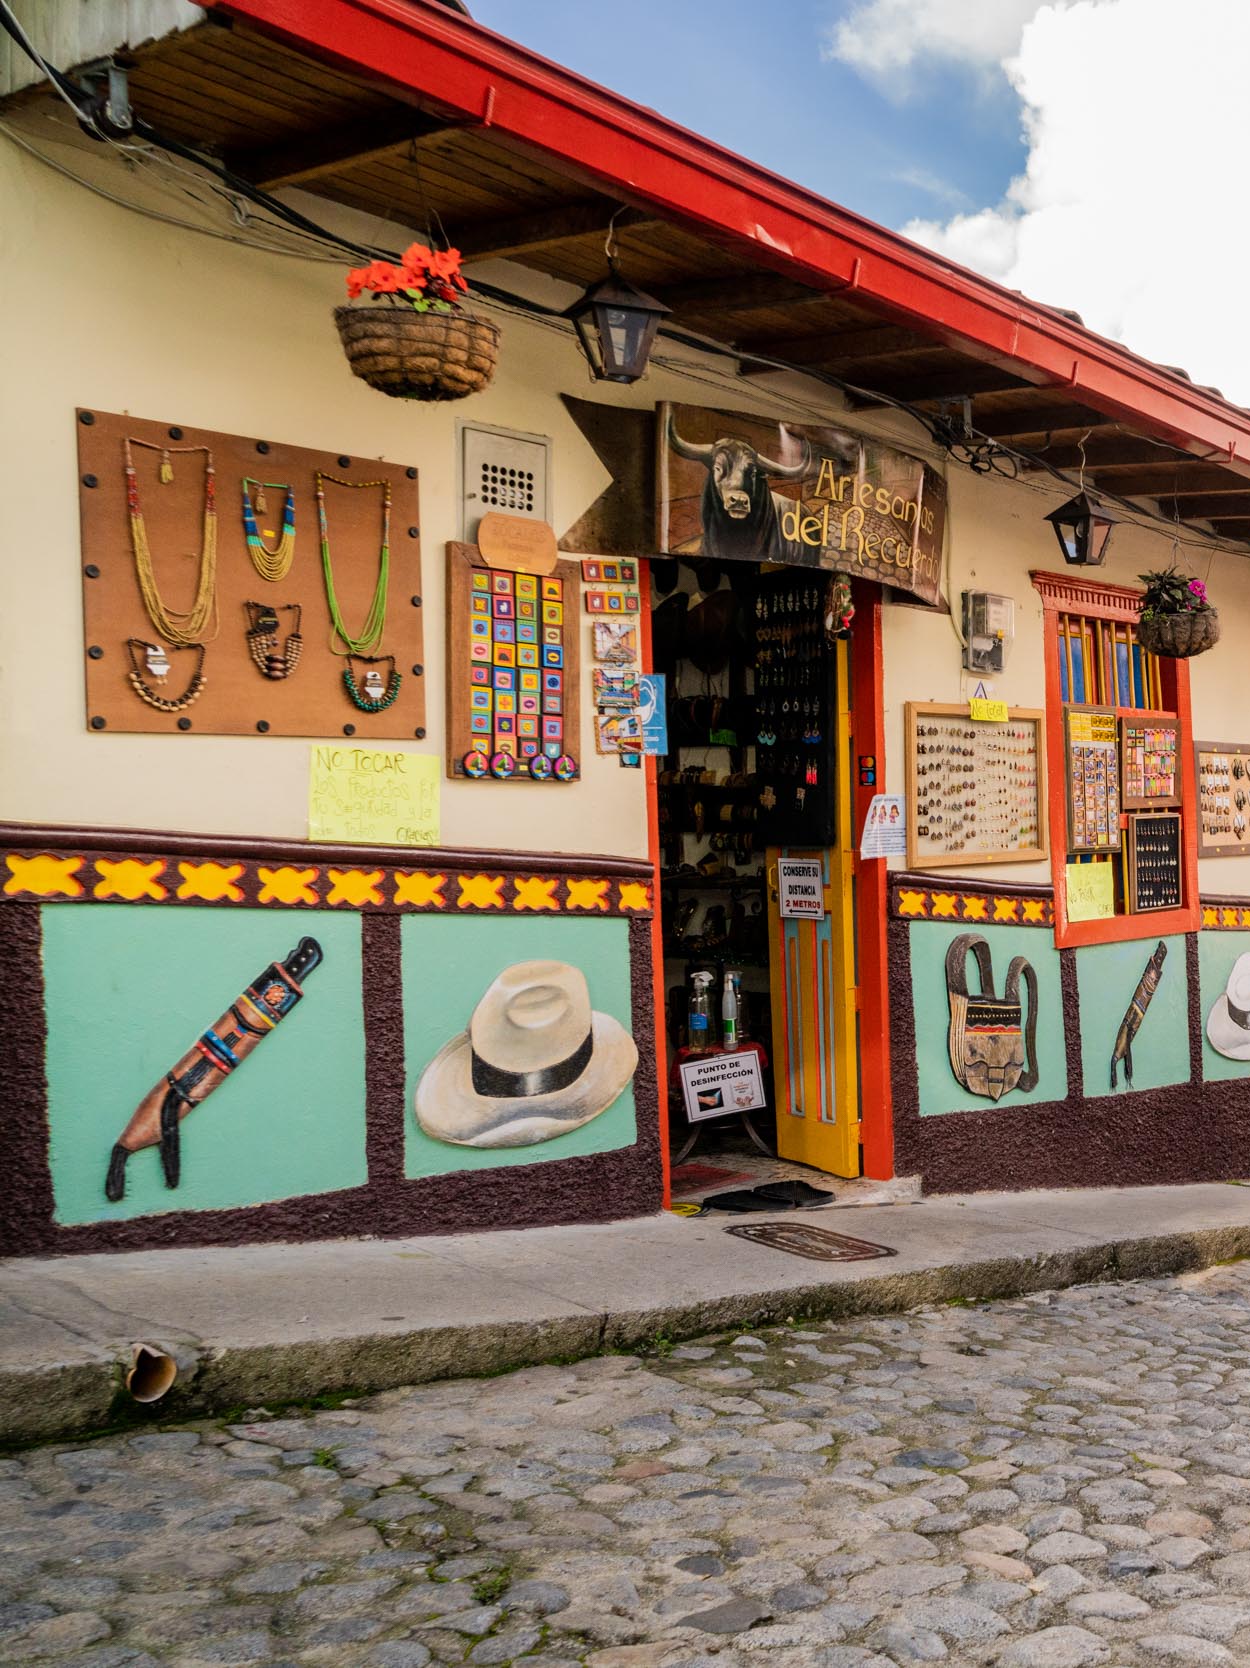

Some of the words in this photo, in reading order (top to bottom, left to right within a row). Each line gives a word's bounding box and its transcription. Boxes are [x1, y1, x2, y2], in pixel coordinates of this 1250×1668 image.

[814, 457, 934, 536] Artesanas
[781, 500, 829, 547] del
[838, 505, 939, 583] Recuerdo
[316, 747, 342, 772] NO
[350, 749, 408, 775] TOCAR
[783, 866, 812, 877] CONSERVE
[812, 866, 819, 877] SU
[788, 884, 816, 896] DISTANCIA
[785, 899, 791, 908] 2
[793, 900, 821, 909] METROS
[697, 1063, 727, 1075] PUNTO
[729, 1061, 740, 1069] DE
[691, 1069, 753, 1087] DESINFECCIÓN
